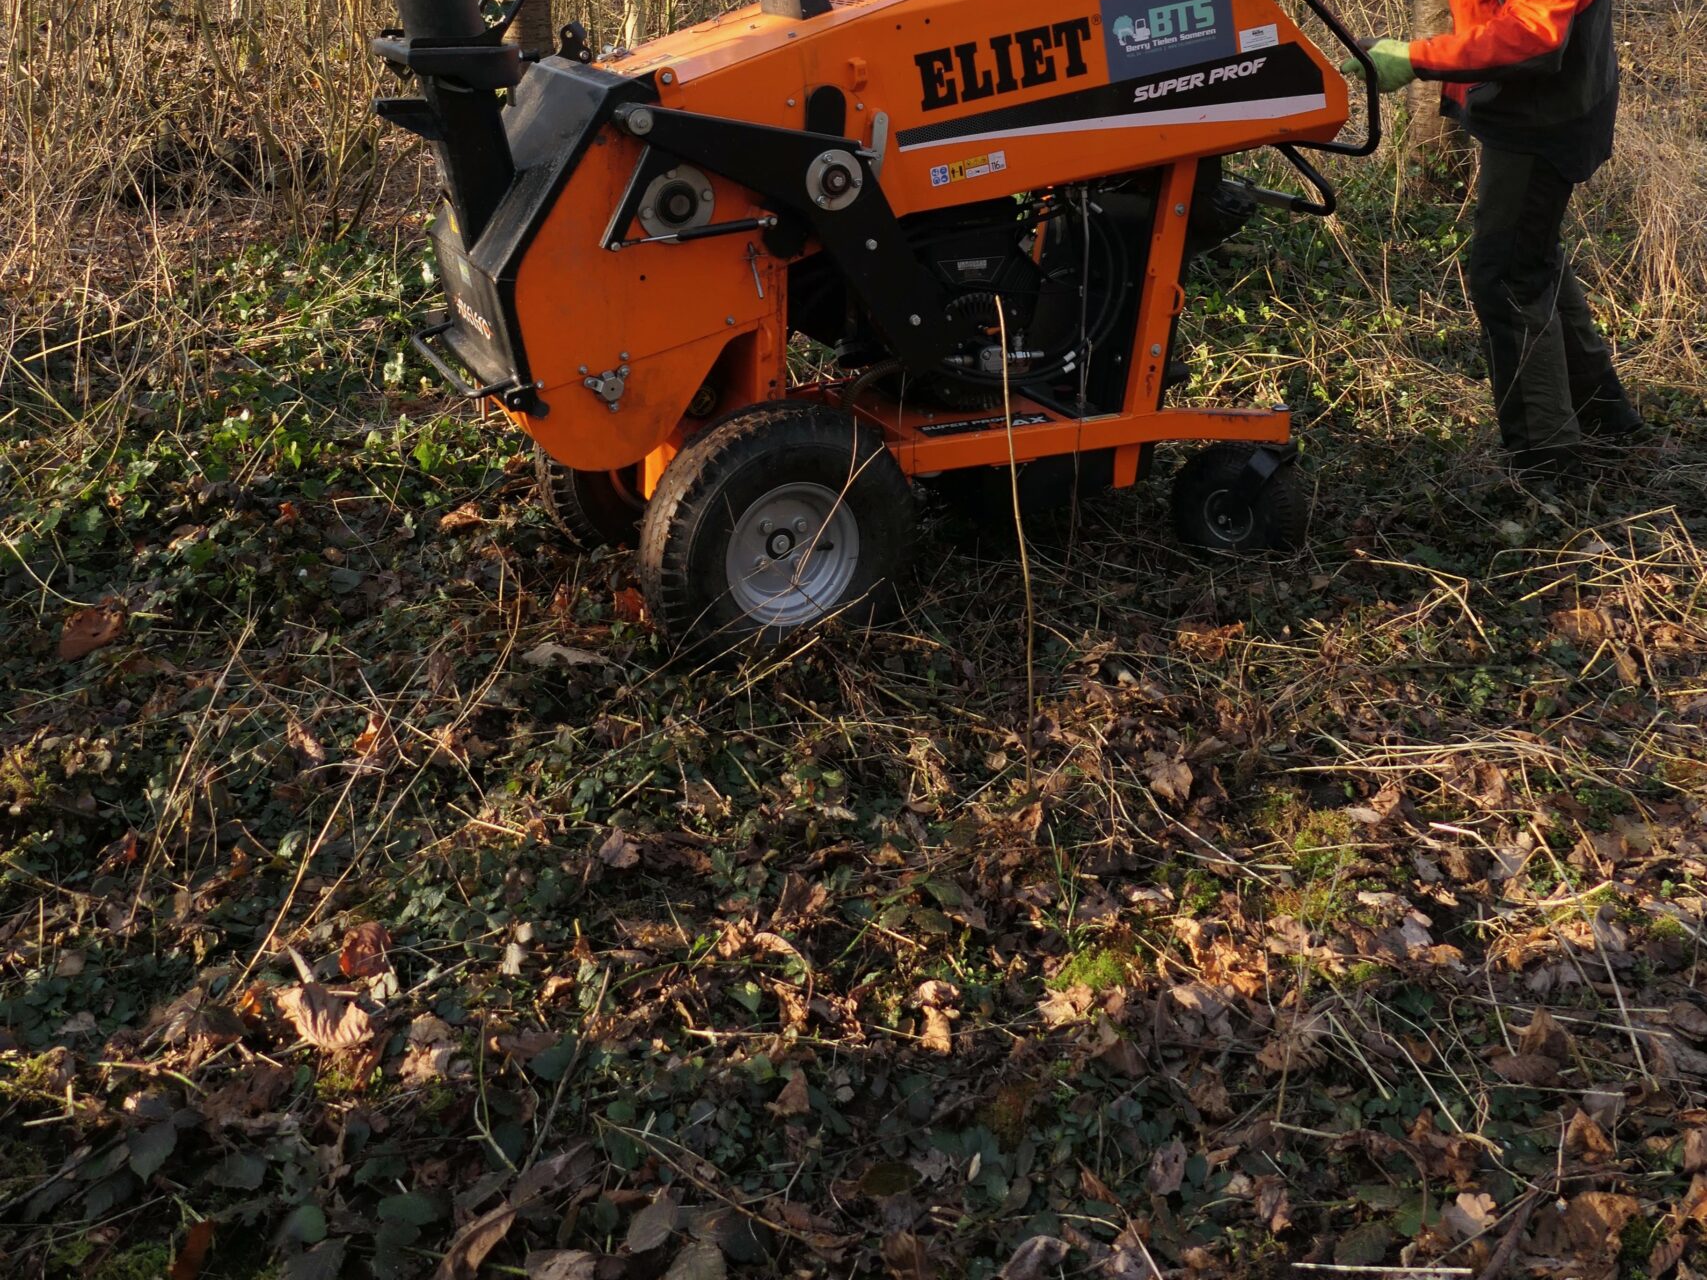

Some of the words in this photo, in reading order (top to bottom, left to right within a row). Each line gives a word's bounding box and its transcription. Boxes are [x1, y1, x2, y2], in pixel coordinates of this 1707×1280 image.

[1125, 41, 1151, 53] Berry
[1152, 36, 1178, 47] Tielen
[1179, 28, 1217, 41] Someren
[1133, 71, 1205, 103] SUPER
[1208, 56, 1267, 85] PROF
[921, 421, 968, 431] SUPER
